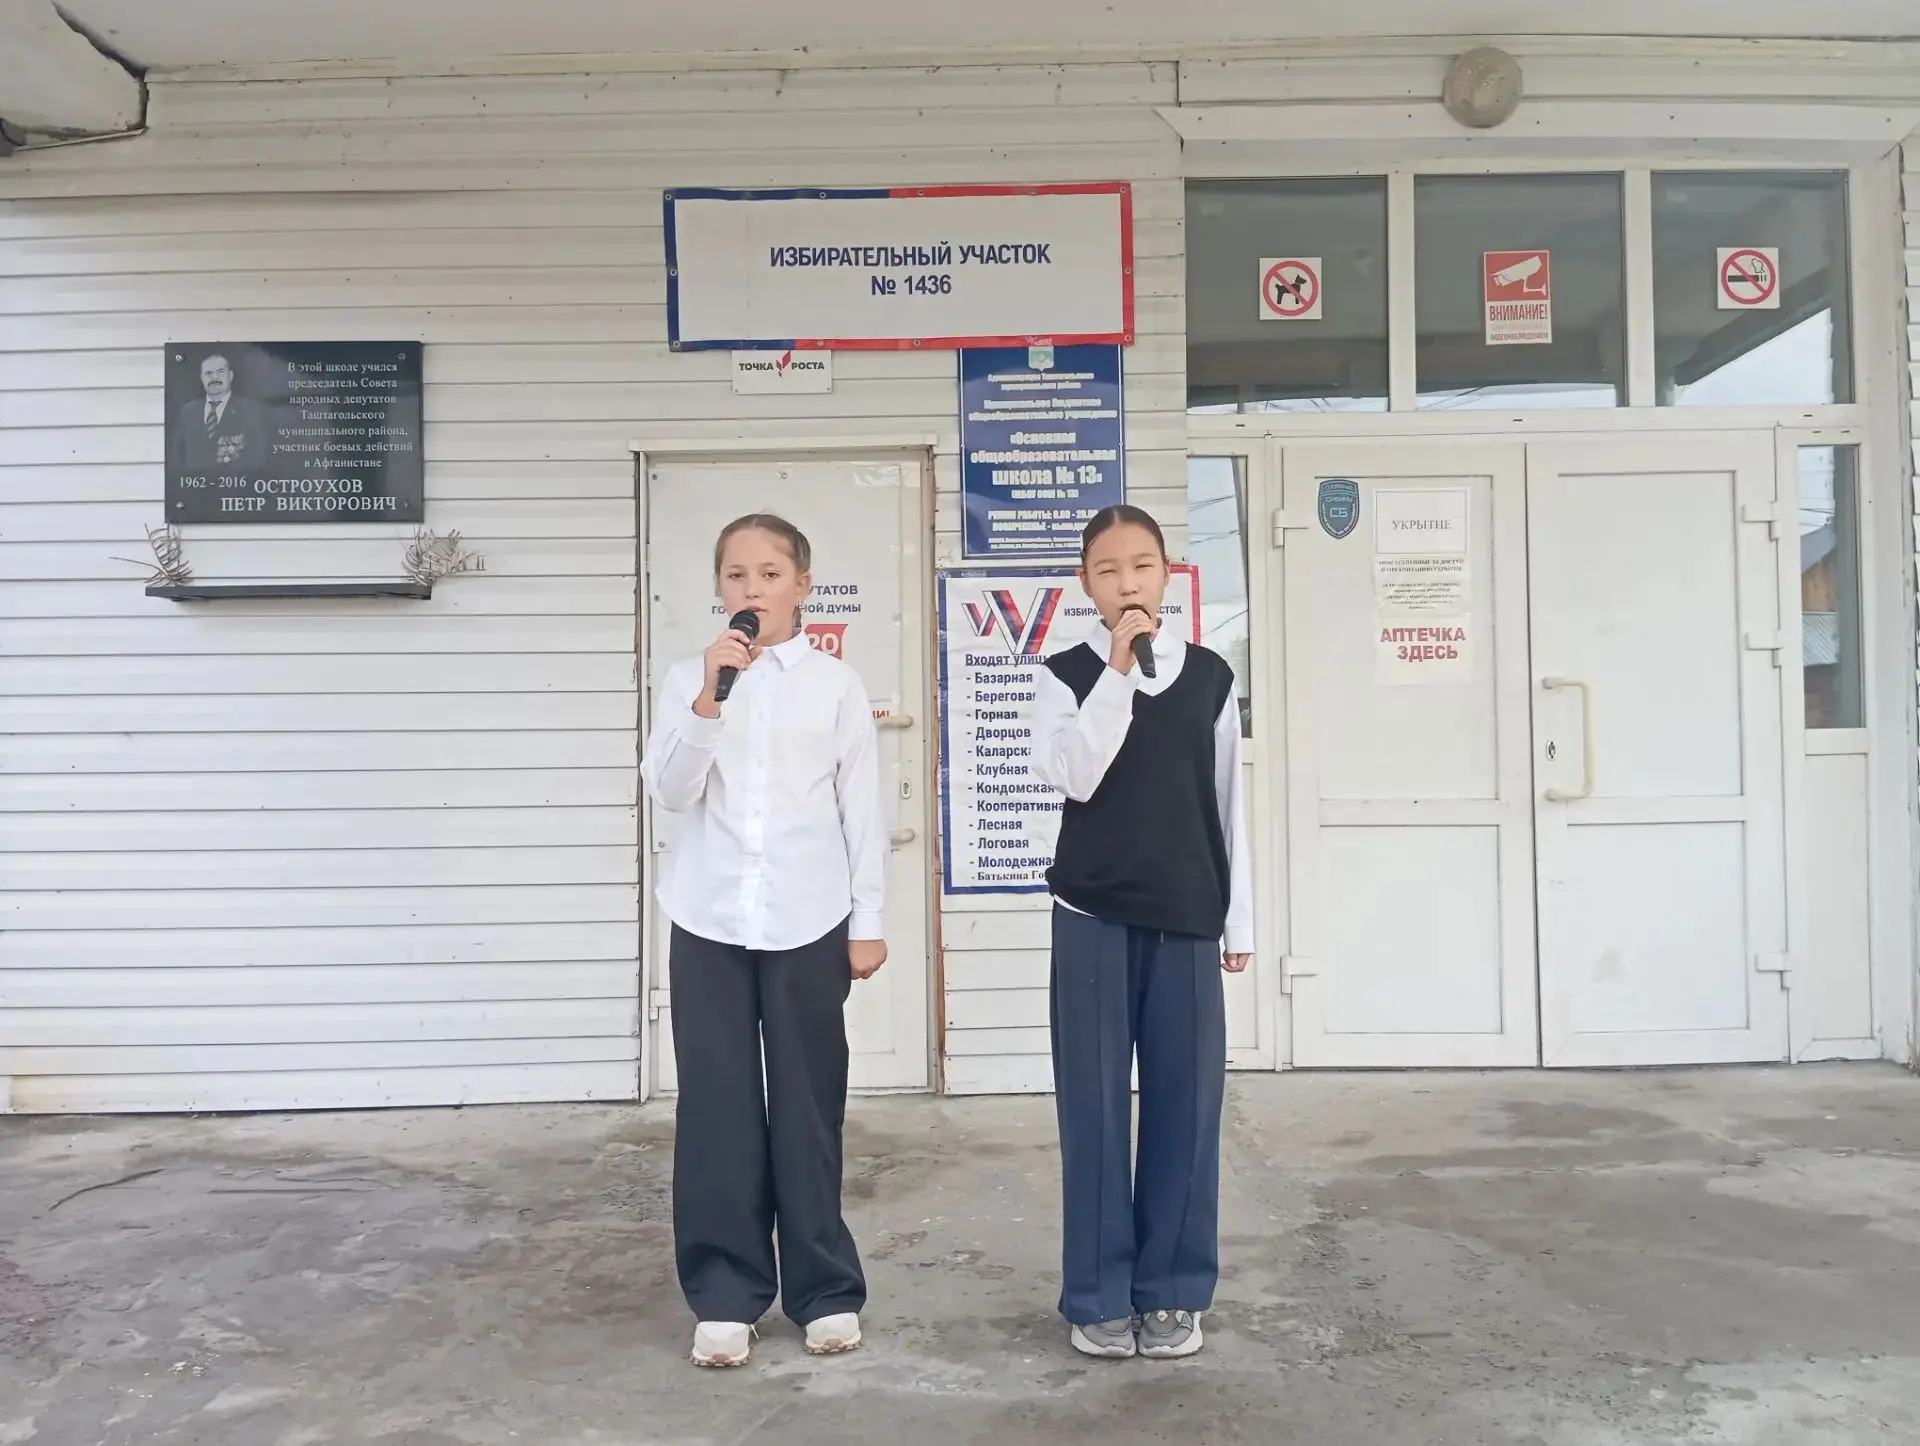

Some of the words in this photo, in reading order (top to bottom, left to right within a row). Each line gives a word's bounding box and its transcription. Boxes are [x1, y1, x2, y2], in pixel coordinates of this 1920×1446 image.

[770, 242, 952, 267] ИЗБИРАТЕЛЬНЫЙ
[958, 243, 1051, 265] УЧАСТОК
[871, 275, 896, 295] №
[903, 274, 952, 295] 1436
[1489, 303, 1548, 321] ВНИМАНИЕ!
[287, 362, 295, 372] В
[299, 361, 322, 372] этой
[325, 363, 358, 372] школе
[361, 363, 398, 374] учился
[738, 362, 774, 371] ТОЧКА
[791, 361, 825, 370] РОСТА
[288, 379, 358, 390] председатель
[360, 377, 397, 388] Совета
[289, 395, 340, 406] народных
[343, 395, 397, 406] депутатов
[300, 409, 385, 420] Таштагольского
[278, 428, 365, 438] муниципального
[367, 425, 408, 438] района,
[272, 444, 320, 454] участник
[323, 441, 361, 452] боевых
[364, 441, 413, 453] действий
[312, 457, 382, 470] Афганистане
[179, 477, 206, 488] 1962
[218, 477, 247, 488] 2016
[254, 479, 363, 493] ОСТРОУХОВ
[221, 497, 266, 511] ПЕТР
[277, 496, 397, 511] ВИКТОРОВИЧ
[1330, 507, 1348, 517] СБ
[1392, 520, 1451, 530] УКРЫТИЕ
[827, 604, 861, 614] ДУМЫ
[1380, 627, 1466, 642] АПТЕЧКА
[965, 653, 1010, 667] Входят
[1397, 645, 1458, 663] ЗДЕСЬ
[975, 672, 1033, 685] Базарная
[975, 708, 1018, 722] Горная
[976, 763, 1028, 778] Клубная
[977, 799, 1065, 814] Кооперативна
[977, 818, 1022, 831] Лесная
[977, 837, 1029, 849] Логовая
[978, 856, 1055, 869] Молодежна
[977, 872, 1028, 881] Батькина
